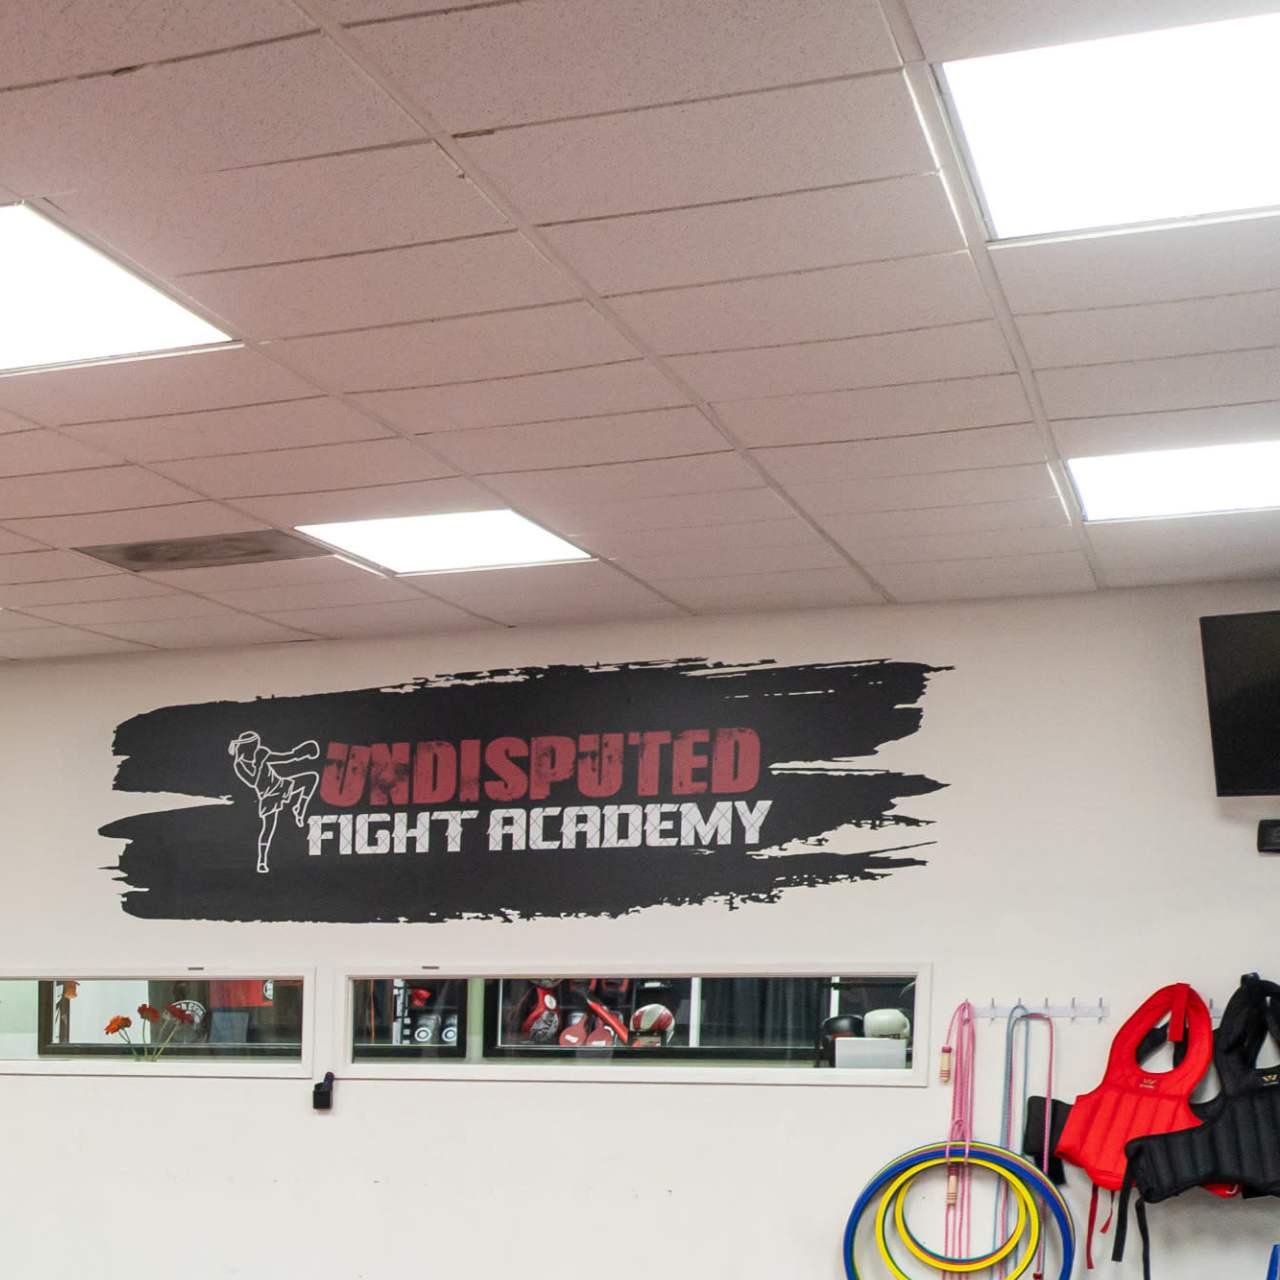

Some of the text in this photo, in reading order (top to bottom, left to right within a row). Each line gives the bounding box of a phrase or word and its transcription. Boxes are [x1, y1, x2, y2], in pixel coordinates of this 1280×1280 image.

[320, 727, 761, 807] UNDISPUTED
[306, 800, 773, 856] FIGHT ACADEMY
